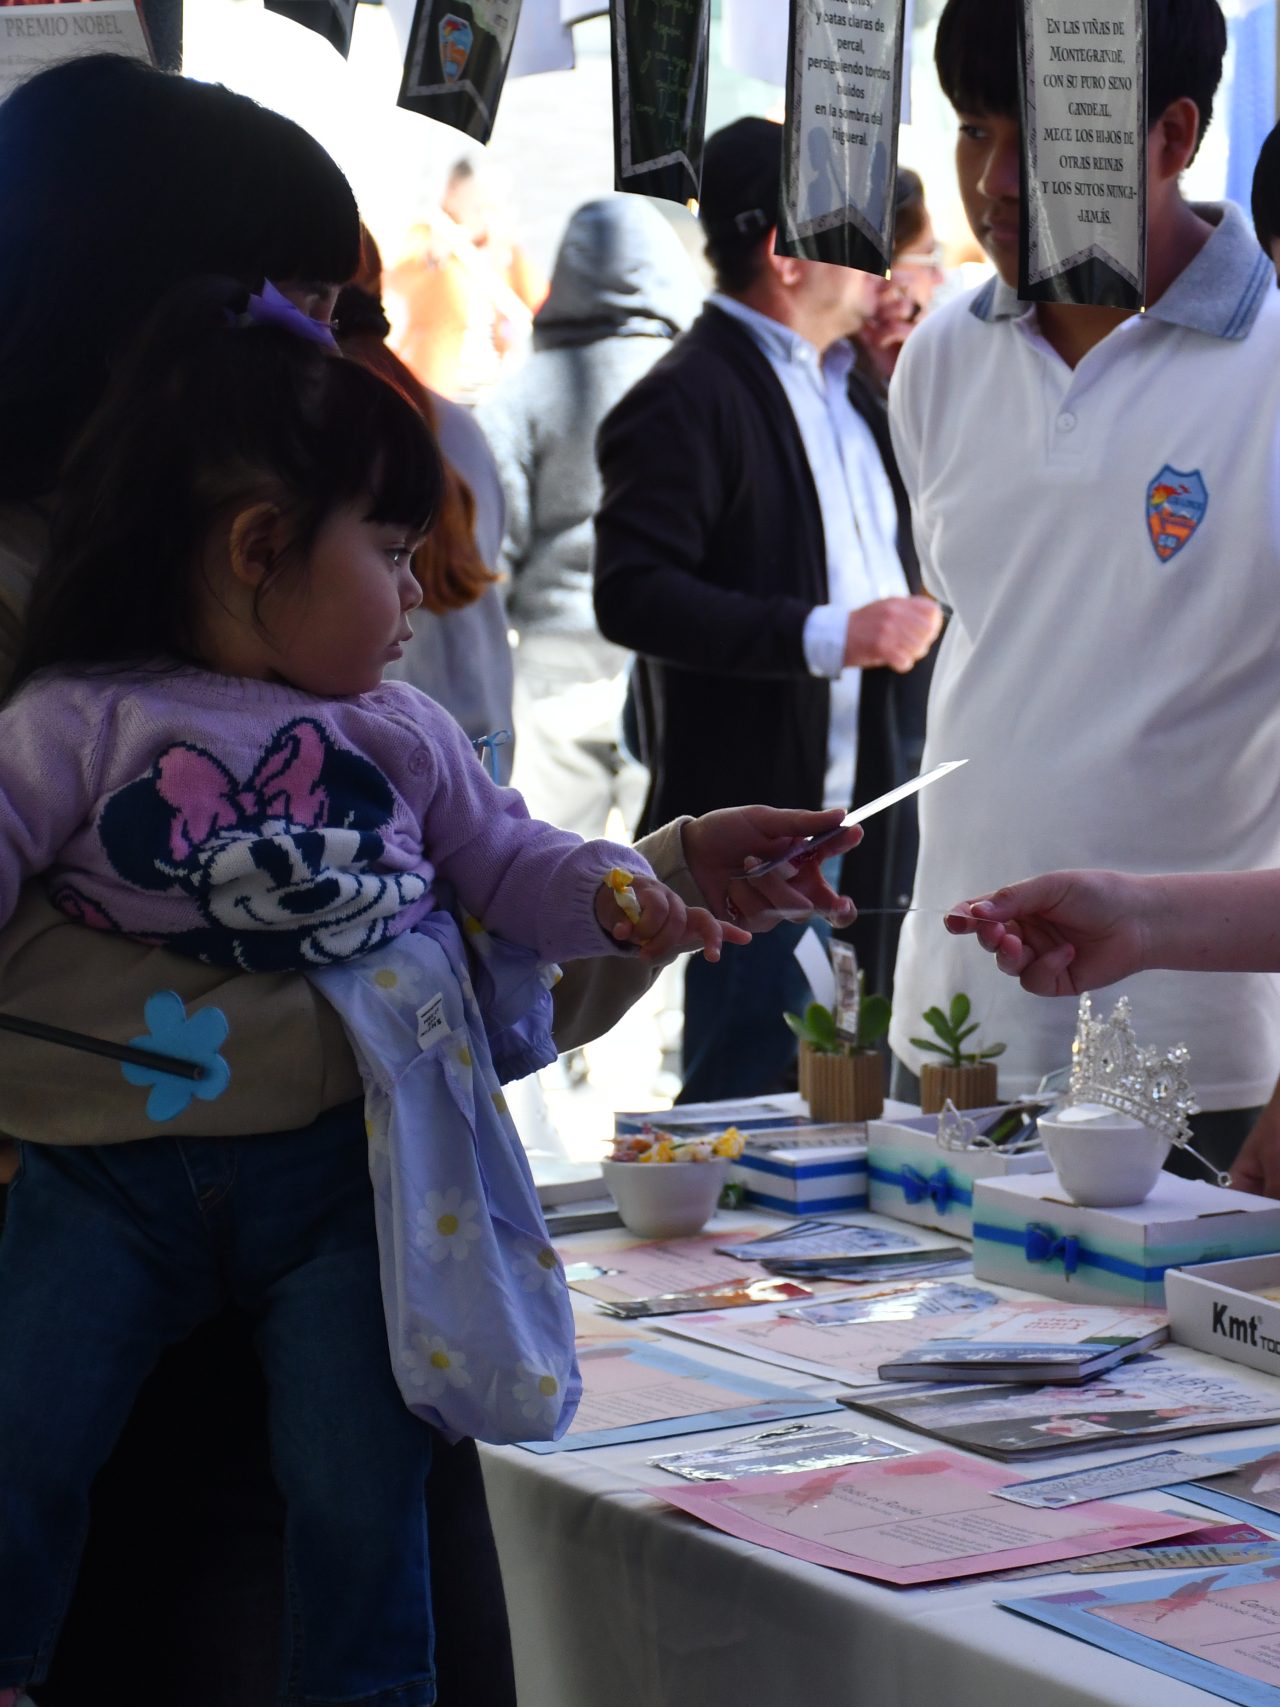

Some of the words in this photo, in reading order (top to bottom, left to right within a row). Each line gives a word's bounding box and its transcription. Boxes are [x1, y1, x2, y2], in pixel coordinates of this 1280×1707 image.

[5, 16, 69, 38] PREMIO
[73, 14, 123, 36] NOBEL
[816, 12, 822, 26] y
[823, 11, 847, 26] batas
[848, 14, 873, 31] claras
[874, 18, 885, 32] de
[1082, 18, 1111, 35] VIÑAS
[1112, 21, 1125, 35] DE
[836, 38, 865, 54] percal,
[808, 57, 864, 76] persiguiendo
[865, 64, 891, 80] tordos
[836, 82, 865, 99] huidos
[1043, 74, 1064, 88] CON
[1066, 74, 1078, 89] SU
[1080, 75, 1106, 90] PURO
[1108, 75, 1132, 91] SENO
[815, 104, 827, 115] en
[828, 103, 837, 117] la
[838, 107, 870, 123] sombra
[871, 111, 883, 126] del
[832, 126, 868, 146] higueral.
[1043, 127, 1072, 141] MECE
[1075, 128, 1094, 143] LOS
[1095, 129, 1122, 144] HIJOS
[1123, 131, 1134, 145] DE
[1059, 155, 1091, 170] OTRAS
[1092, 156, 1124, 172] REINAS
[1041, 181, 1049, 194] Y
[1051, 181, 1072, 195] LOS
